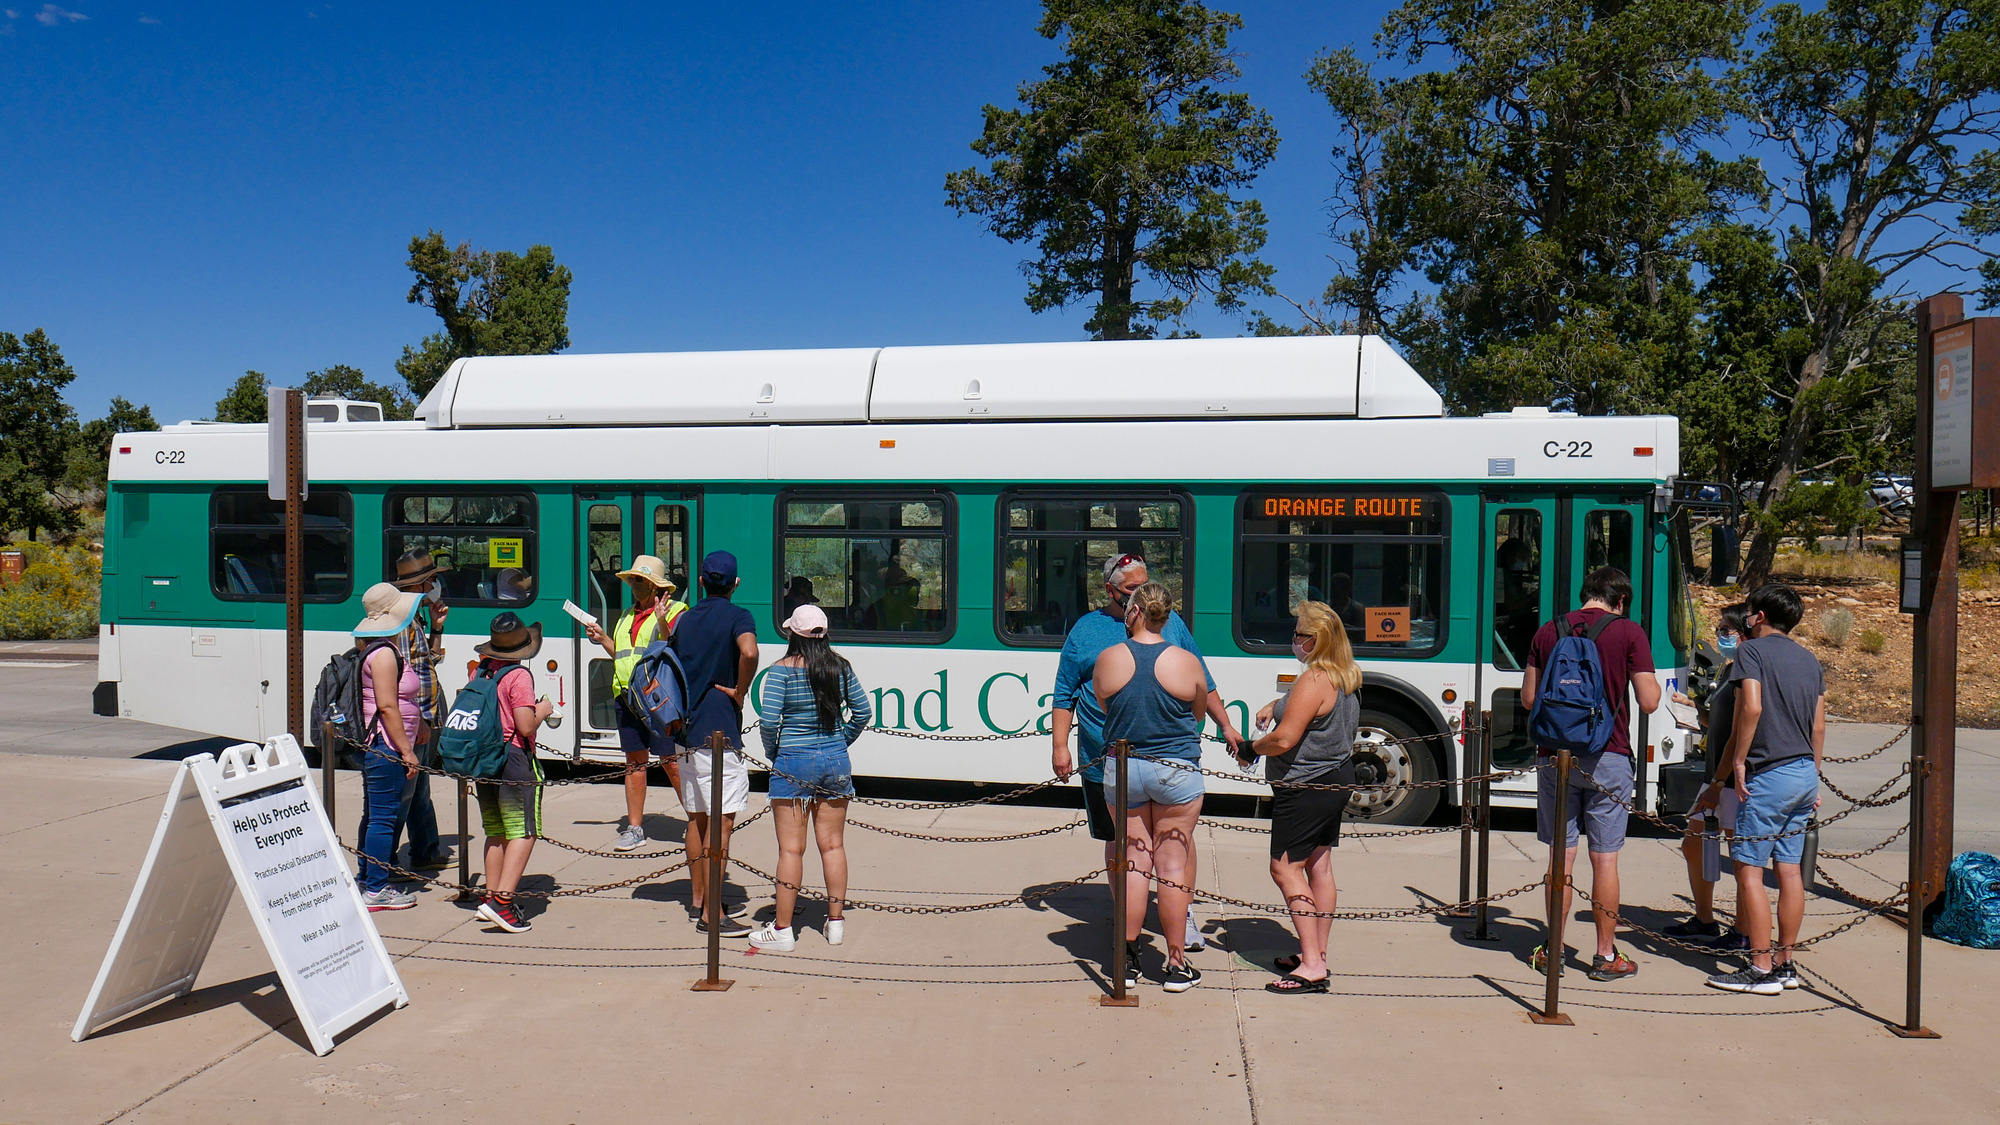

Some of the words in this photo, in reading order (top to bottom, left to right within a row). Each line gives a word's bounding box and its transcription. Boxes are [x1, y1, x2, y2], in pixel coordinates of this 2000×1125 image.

[155, 450, 185, 464] C-22
[1543, 440, 1592, 458] C-22
[1265, 498, 1346, 516] ORANGE
[1354, 498, 1422, 516] ROUTE
[445, 709, 480, 730] VANS
[232, 816, 258, 834] Help
[258, 812, 272, 826] Us
[272, 800, 311, 821] Protect
[255, 826, 304, 849] Everyone
[254, 866, 279, 880] Practice
[278, 858, 297, 872] Social
[295, 849, 327, 866] Distancing
[268, 896, 285, 909] Keep
[283, 894, 289, 903] 6
[288, 890, 302, 900] feet
[300, 884, 313, 897] (1.8
[321, 876, 338, 888] away
[281, 907, 298, 918] from
[297, 900, 313, 912] other
[313, 892, 335, 907] people.
[301, 931, 318, 943] Wear
[322, 920, 341, 934] Mask.
